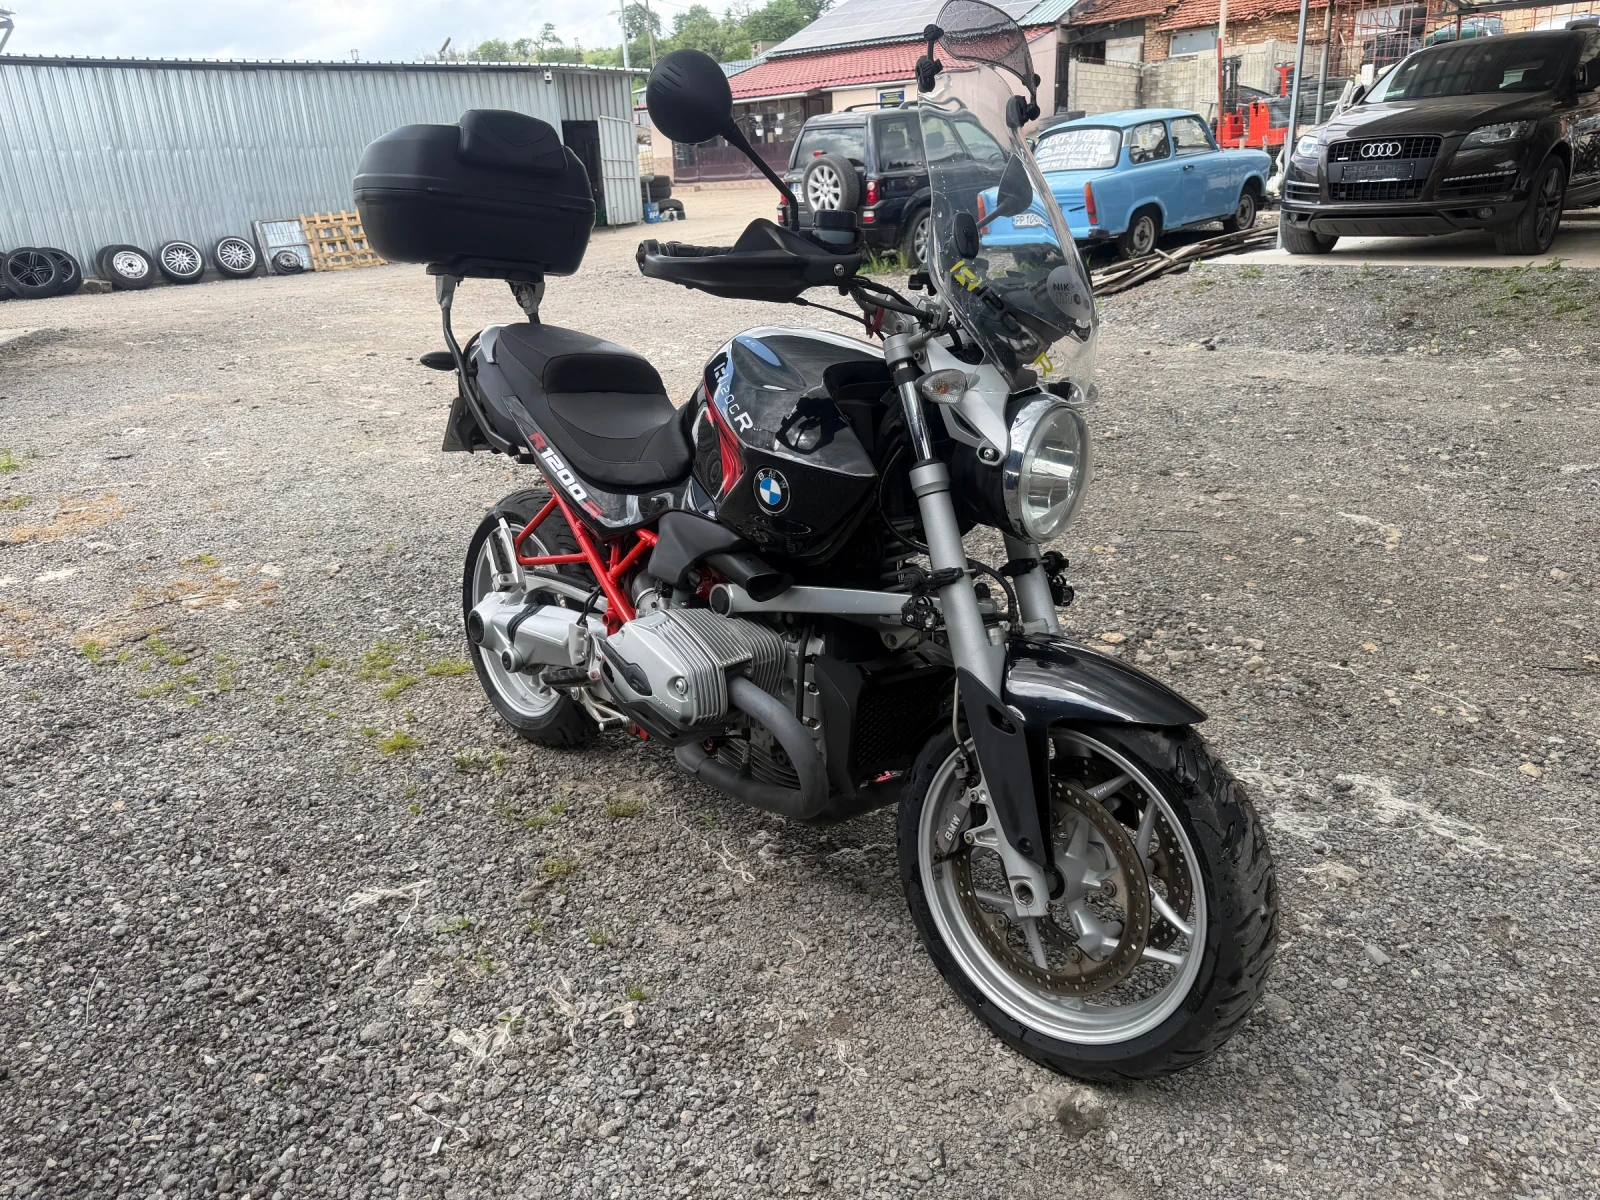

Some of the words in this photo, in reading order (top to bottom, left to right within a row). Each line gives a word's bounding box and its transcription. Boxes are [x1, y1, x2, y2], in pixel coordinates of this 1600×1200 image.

[1041, 131, 1109, 148] RENT-A-CAR
[758, 470, 788, 489] BMW
[944, 814, 961, 841] BMW
